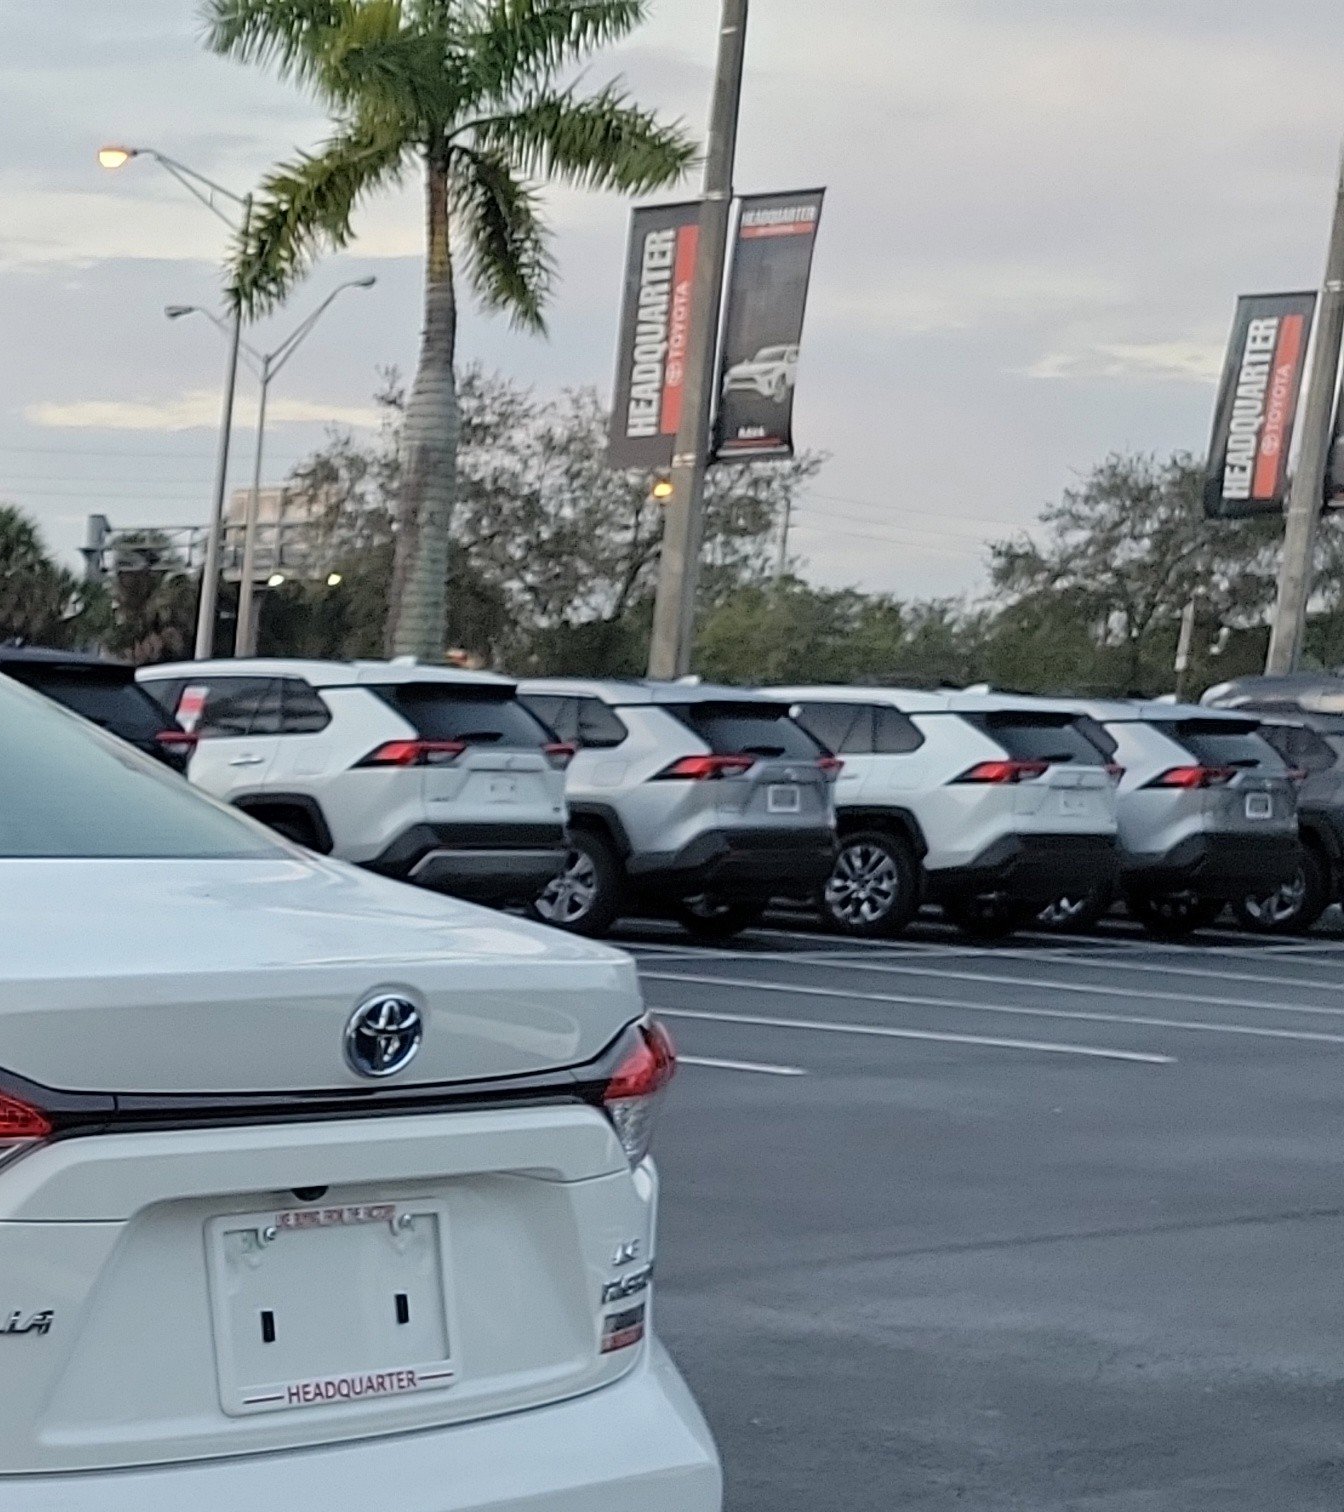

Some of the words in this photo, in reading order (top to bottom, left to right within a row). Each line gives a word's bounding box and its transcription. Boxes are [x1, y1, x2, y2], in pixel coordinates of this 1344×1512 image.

[626, 227, 678, 438] HEADQUARTER
[667, 280, 692, 362] TOYOTA
[1222, 317, 1280, 499] HEADQUARTER
[286, 1370, 418, 1404] HEADQUARTER
